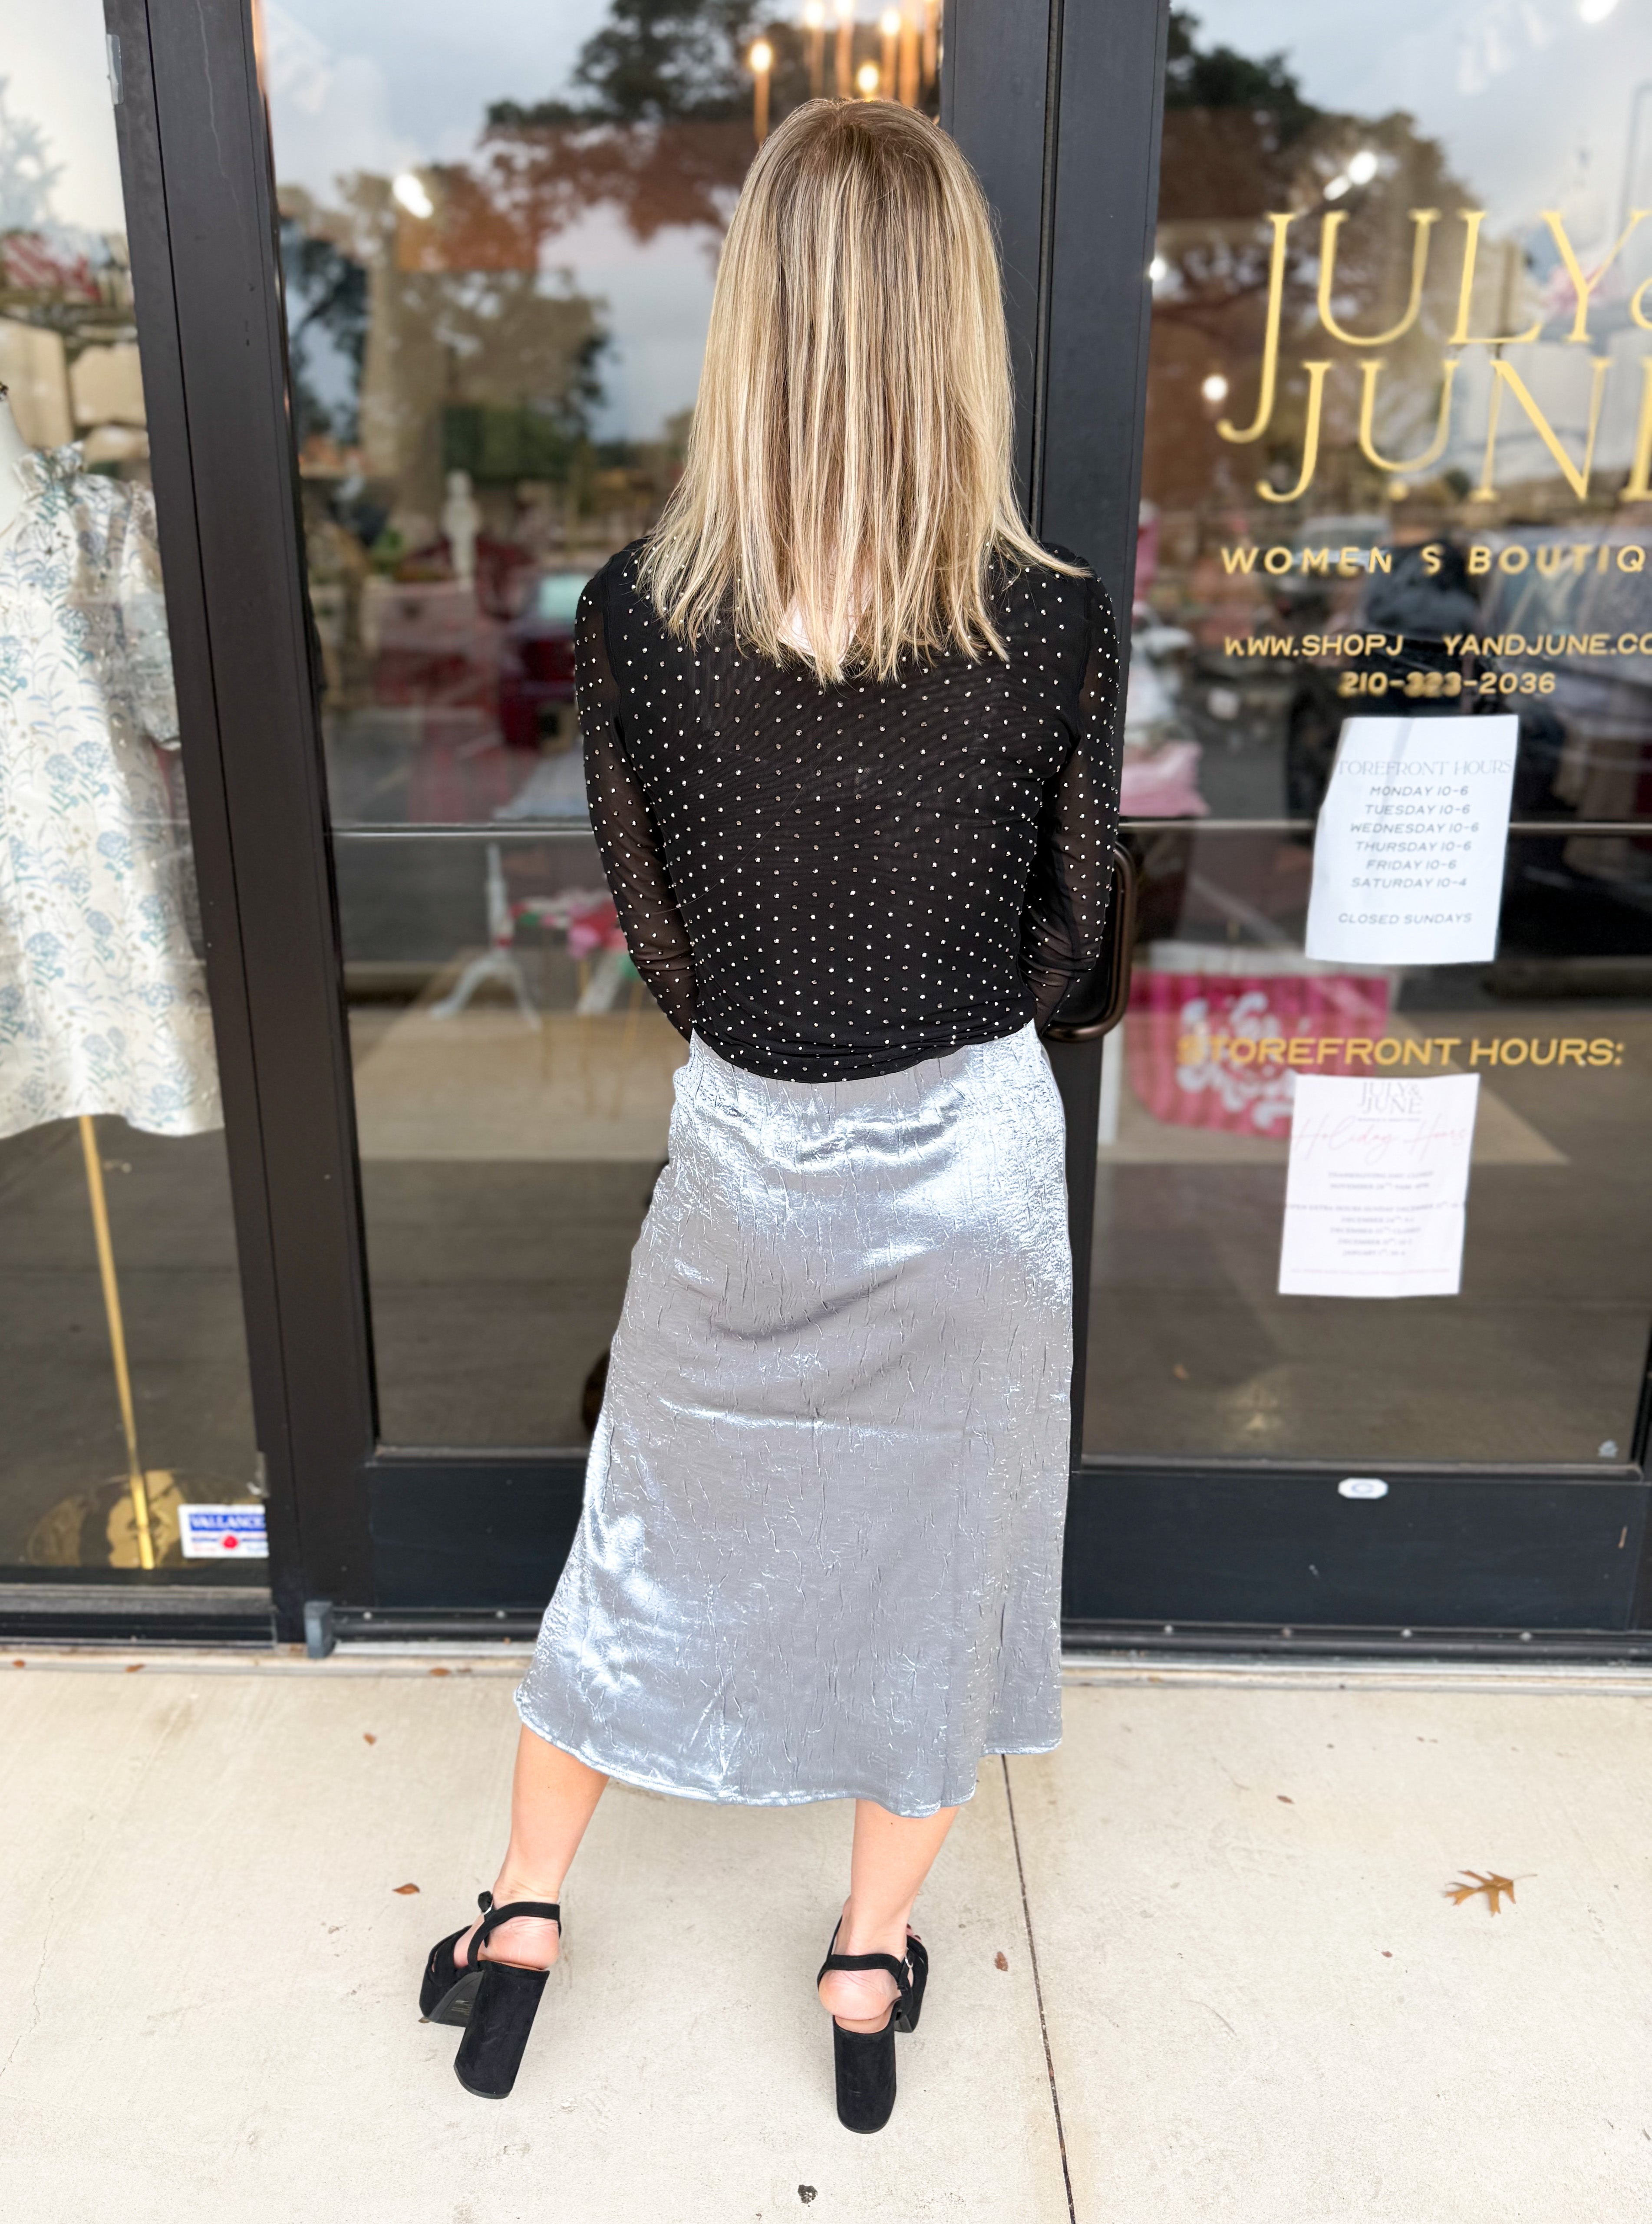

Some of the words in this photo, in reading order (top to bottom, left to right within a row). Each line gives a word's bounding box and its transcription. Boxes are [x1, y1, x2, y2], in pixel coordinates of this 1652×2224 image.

[1468, 544, 1646, 577] BOUTIQ
[1454, 760, 1511, 775] HOURS
[1370, 786, 1434, 797] MONDAY
[1437, 785, 1469, 796] 10-6
[1365, 804, 1436, 815] TUESDAY
[1440, 804, 1471, 815] 10-6
[1350, 823, 1445, 834] WEDNESDAY
[1449, 822, 1479, 833] 10-6
[1356, 841, 1437, 852] THURSDAY
[1441, 840, 1472, 851] 10-6
[1366, 860, 1422, 870] FRIDAY
[1425, 859, 1457, 870] 10-6
[1351, 877, 1433, 889] SATURDAY
[1437, 877, 1467, 888] 10-4
[1338, 913, 1400, 925] CLOSED
[1404, 913, 1472, 925] SUNDAYS
[1469, 1038, 1624, 1067] HOURS:
[1362, 1097, 1422, 1114] JUNE
